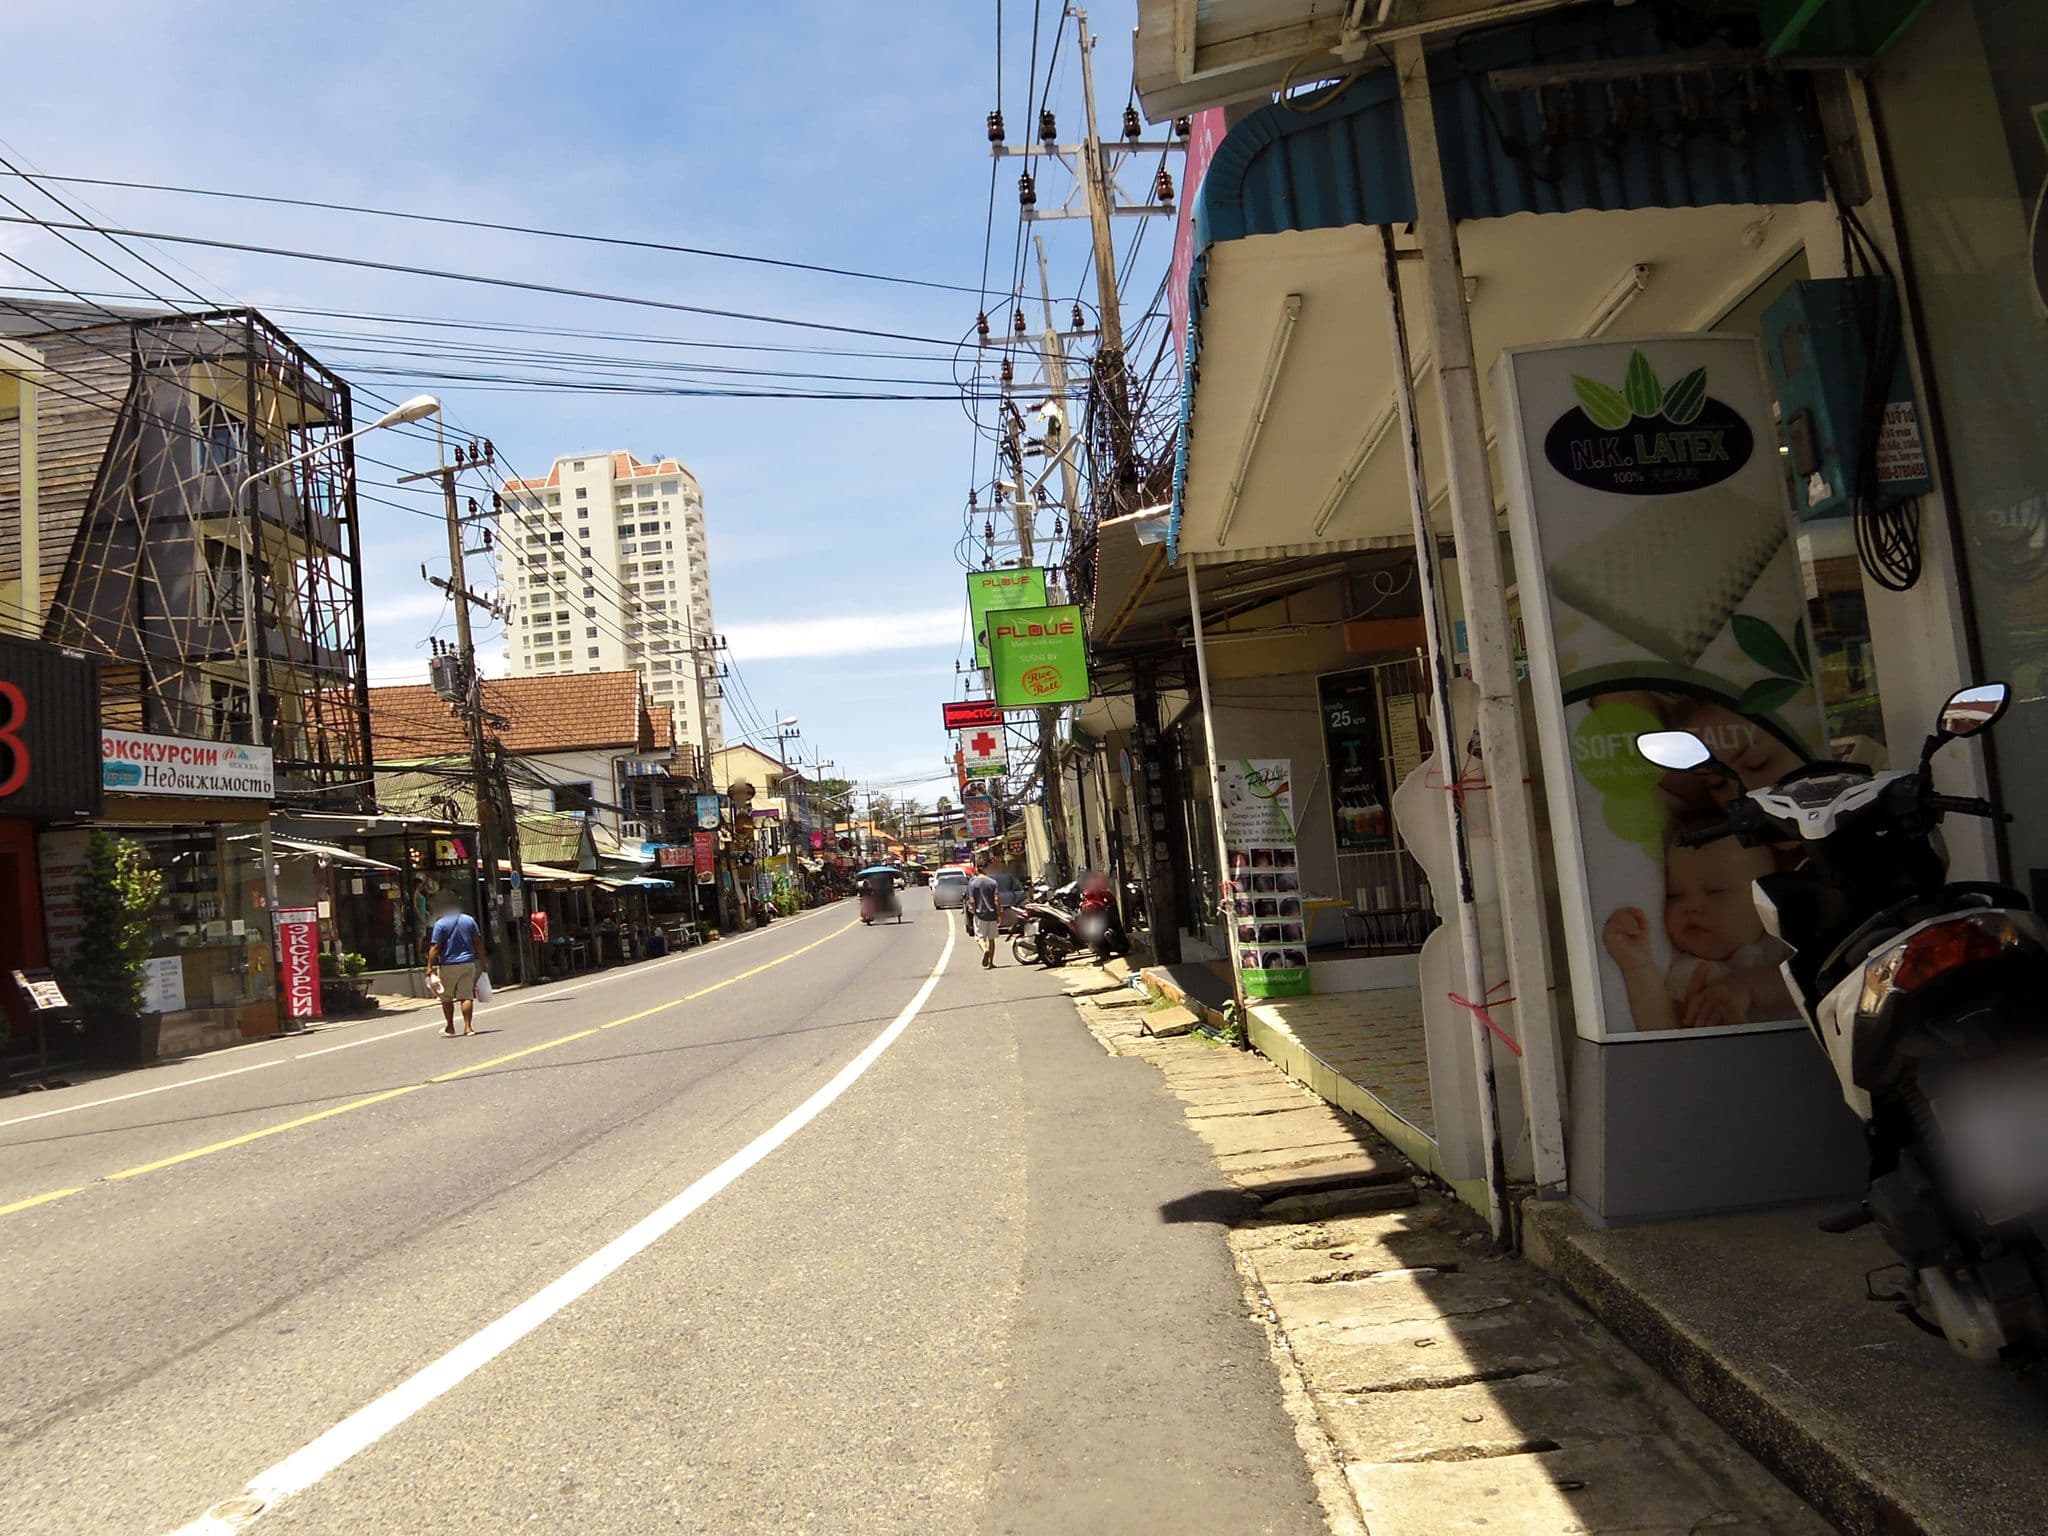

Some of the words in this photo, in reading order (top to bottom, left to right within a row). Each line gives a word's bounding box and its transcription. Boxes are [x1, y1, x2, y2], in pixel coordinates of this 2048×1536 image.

[1570, 436, 1633, 471] N.K.
[1634, 431, 1729, 465] LATEX
[1331, 710, 1352, 728] 25
[102, 738, 218, 767] ЭКСКУРСИИ
[1576, 732, 1637, 760] SOFT
[144, 765, 272, 793] Недвижимость
[288, 923, 313, 1017] ЭКСКУРСИИ
